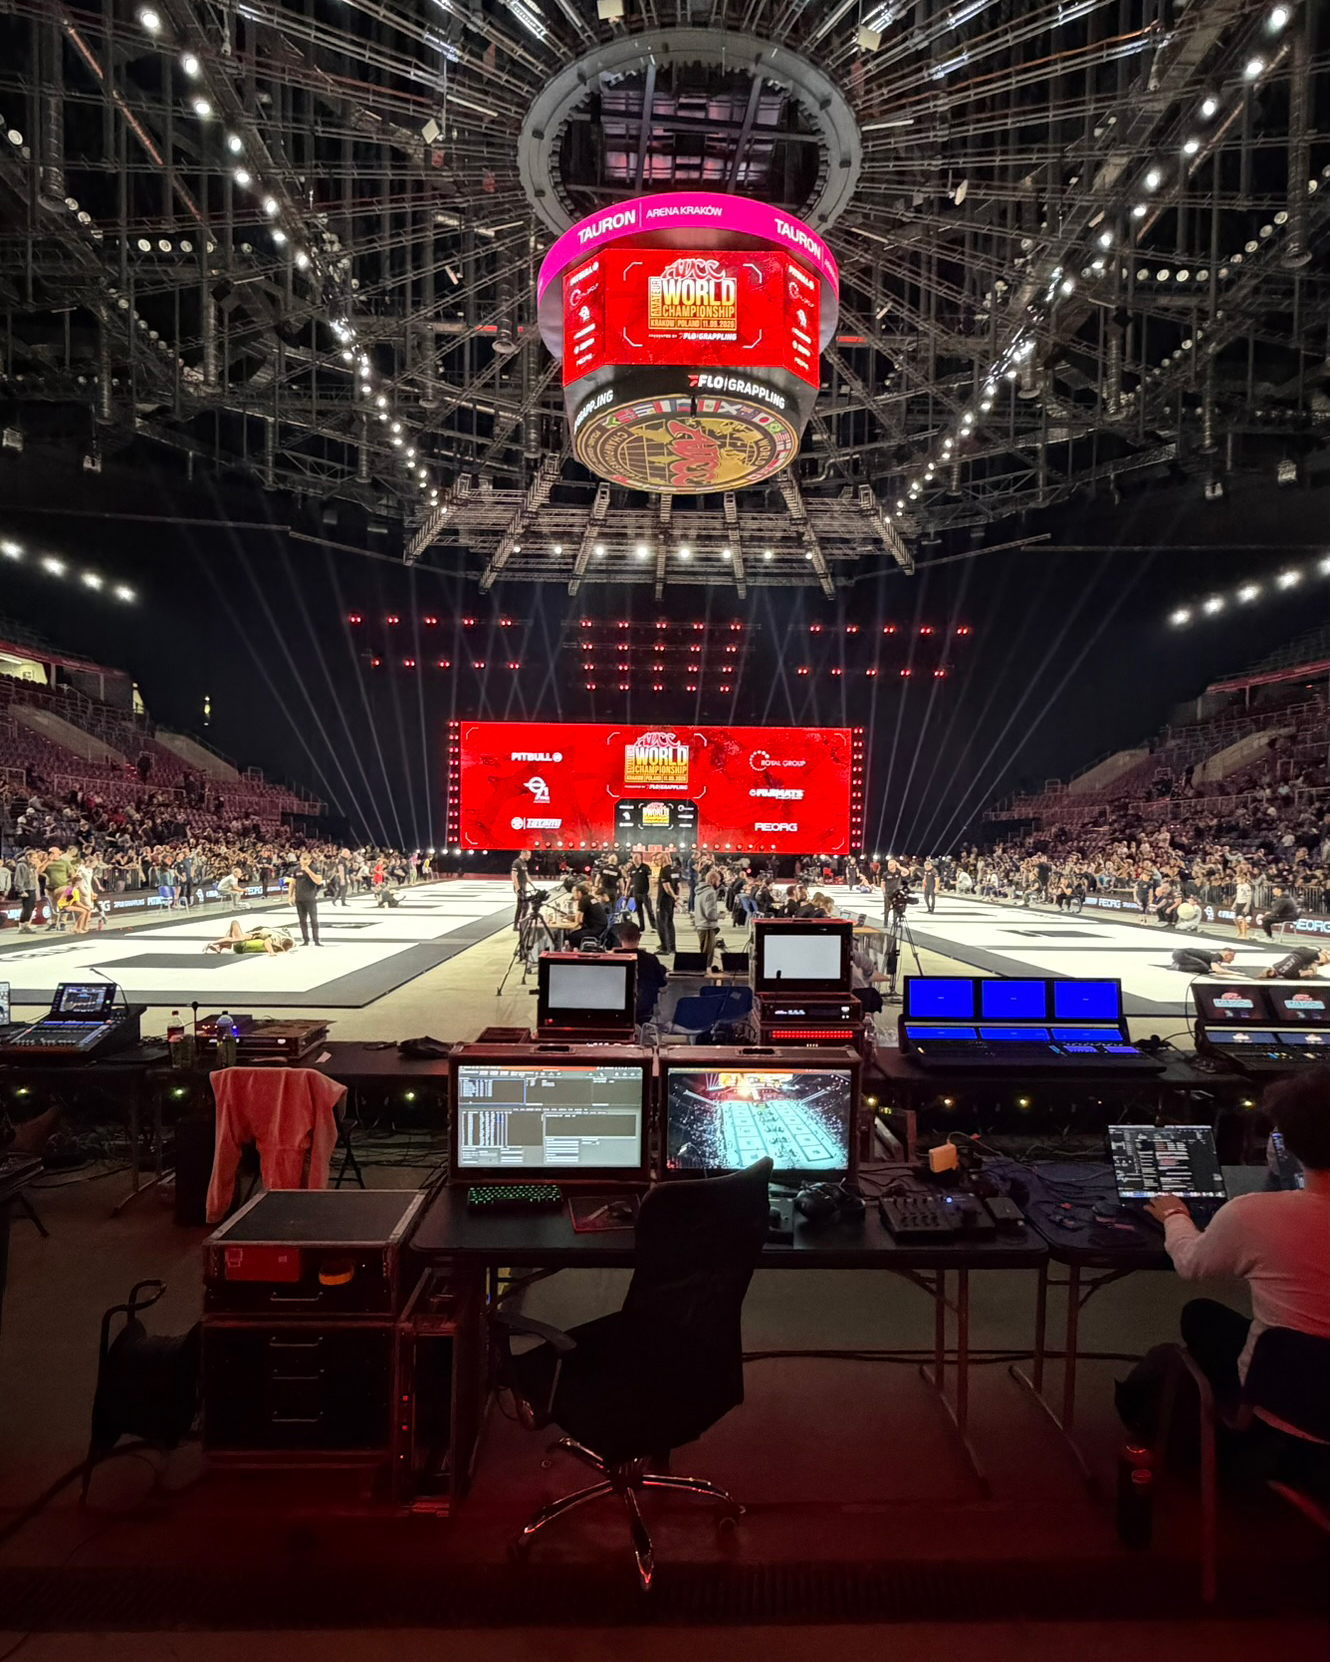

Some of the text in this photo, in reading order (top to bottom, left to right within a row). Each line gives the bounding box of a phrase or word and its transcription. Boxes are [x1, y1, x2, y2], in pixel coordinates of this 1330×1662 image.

[577, 204, 723, 244] TAURON ARENA KRAKÓW
[774, 218, 821, 260] TAURON
[660, 258, 726, 282] ADCC
[651, 280, 661, 317] AMATEUR
[662, 279, 736, 306] WORLD
[662, 305, 736, 318] CHAMPIONSHIP
[755, 439, 771, 465] WORLD
[511, 752, 552, 761] PITBULL
[635, 747, 688, 766] WORLD
[635, 765, 688, 775] CHAMPIONSHIP
[1295, 919, 1330, 933] EORG
